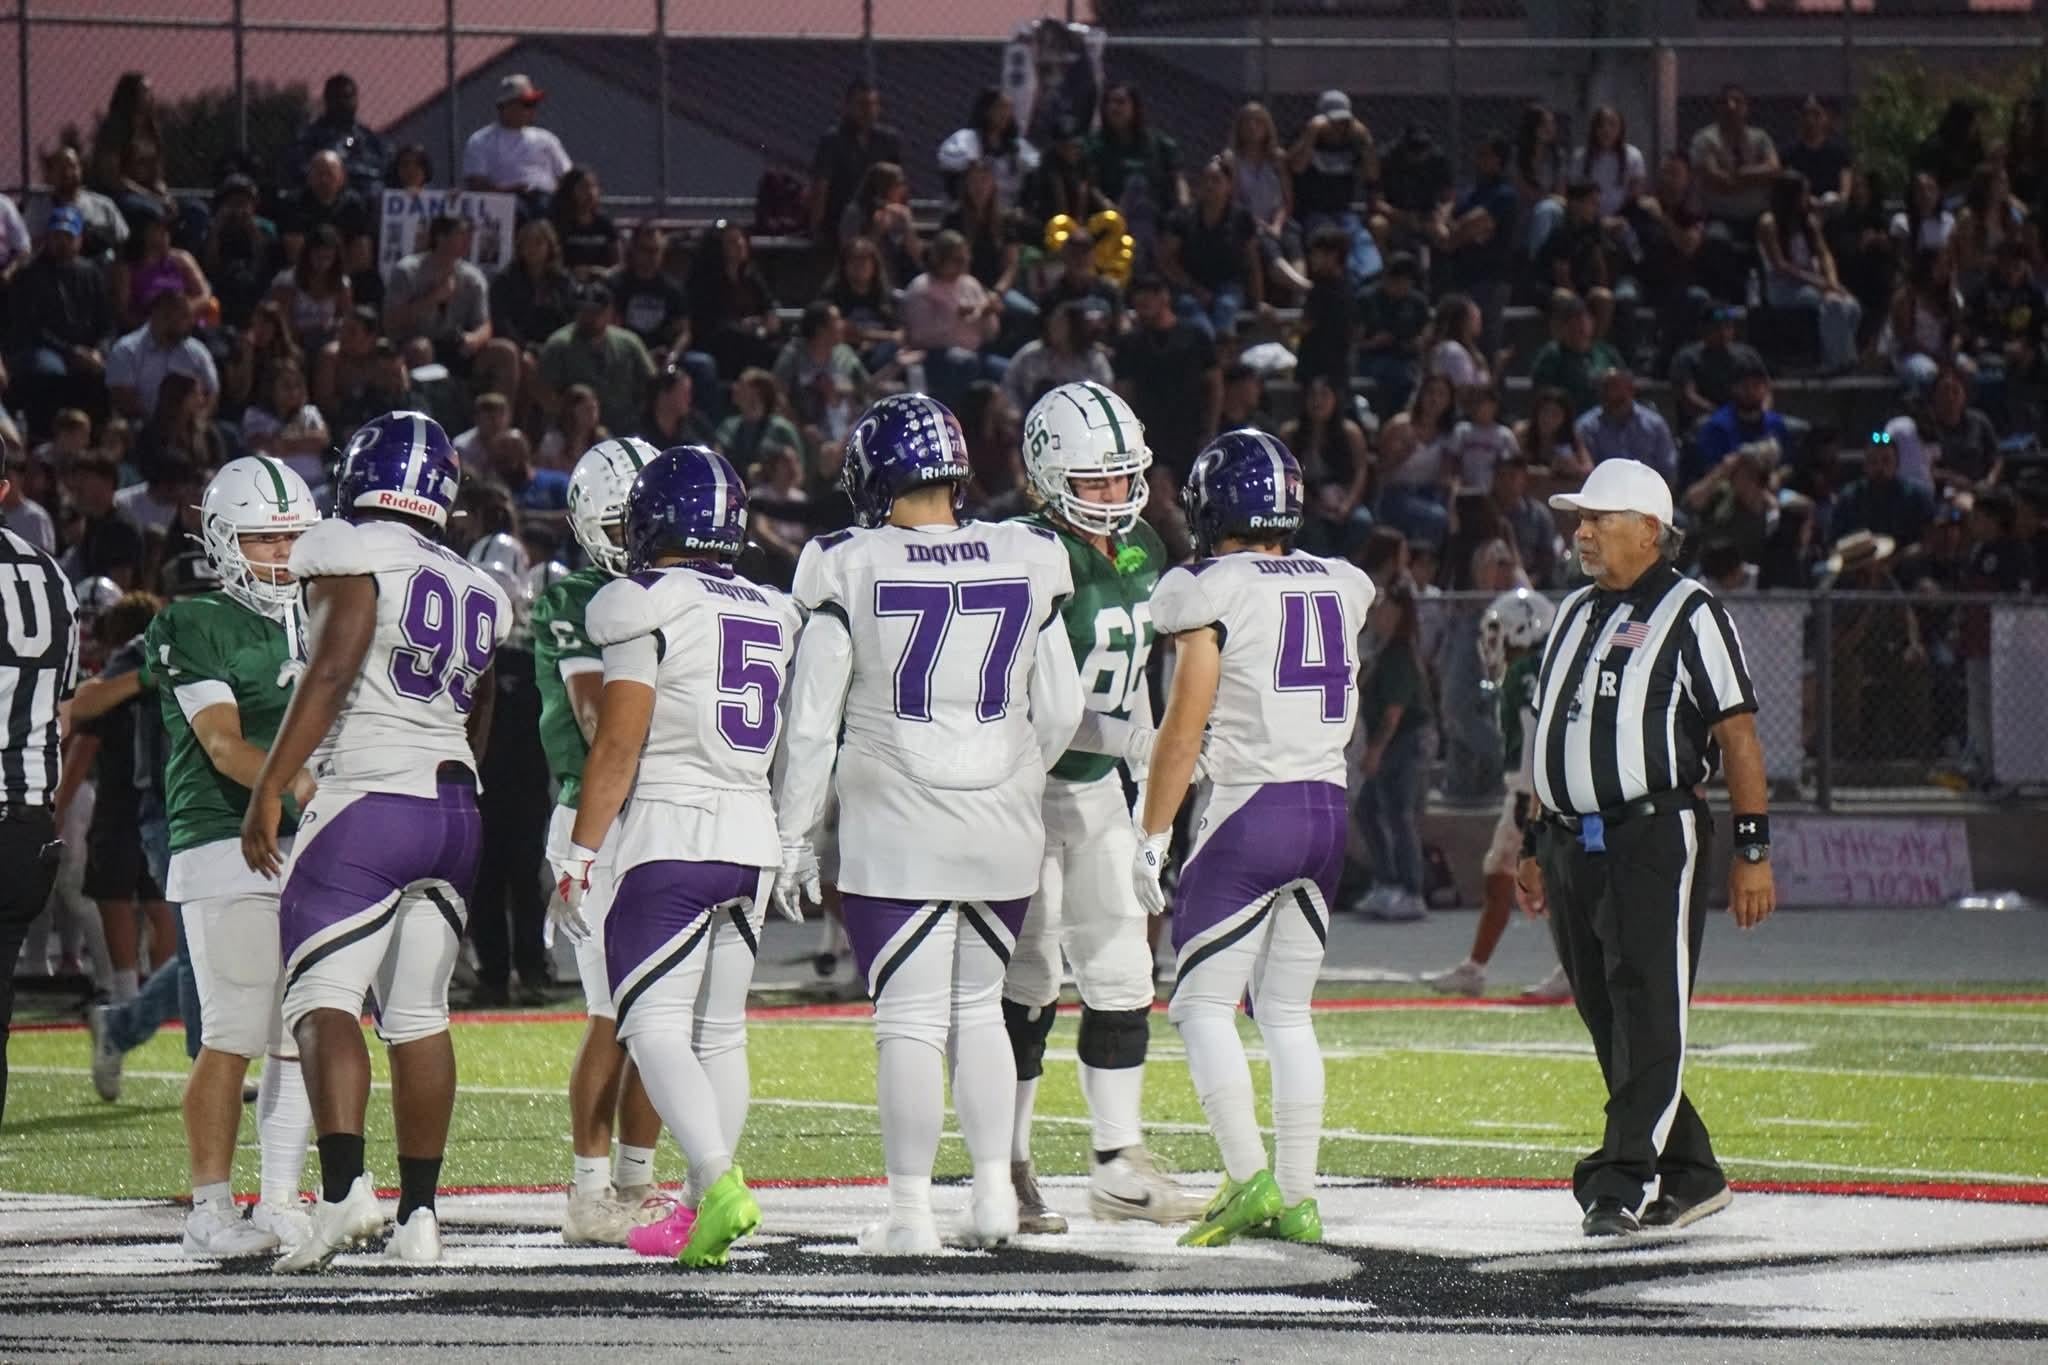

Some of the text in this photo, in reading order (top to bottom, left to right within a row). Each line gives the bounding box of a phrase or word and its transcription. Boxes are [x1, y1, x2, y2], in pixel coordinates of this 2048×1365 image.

[921, 463, 970, 481] Riddell
[271, 514, 300, 522] Riddell
[379, 493, 438, 517] Riddell
[1250, 515, 1300, 529] Riddell
[685, 536, 740, 552] Riddell
[0, 562, 52, 658] U
[387, 564, 497, 715] 99
[549, 620, 582, 650] 6
[874, 576, 1033, 724] 77
[1273, 590, 1355, 724] 4
[716, 612, 784, 755] 5
[1598, 671, 1618, 697] R
